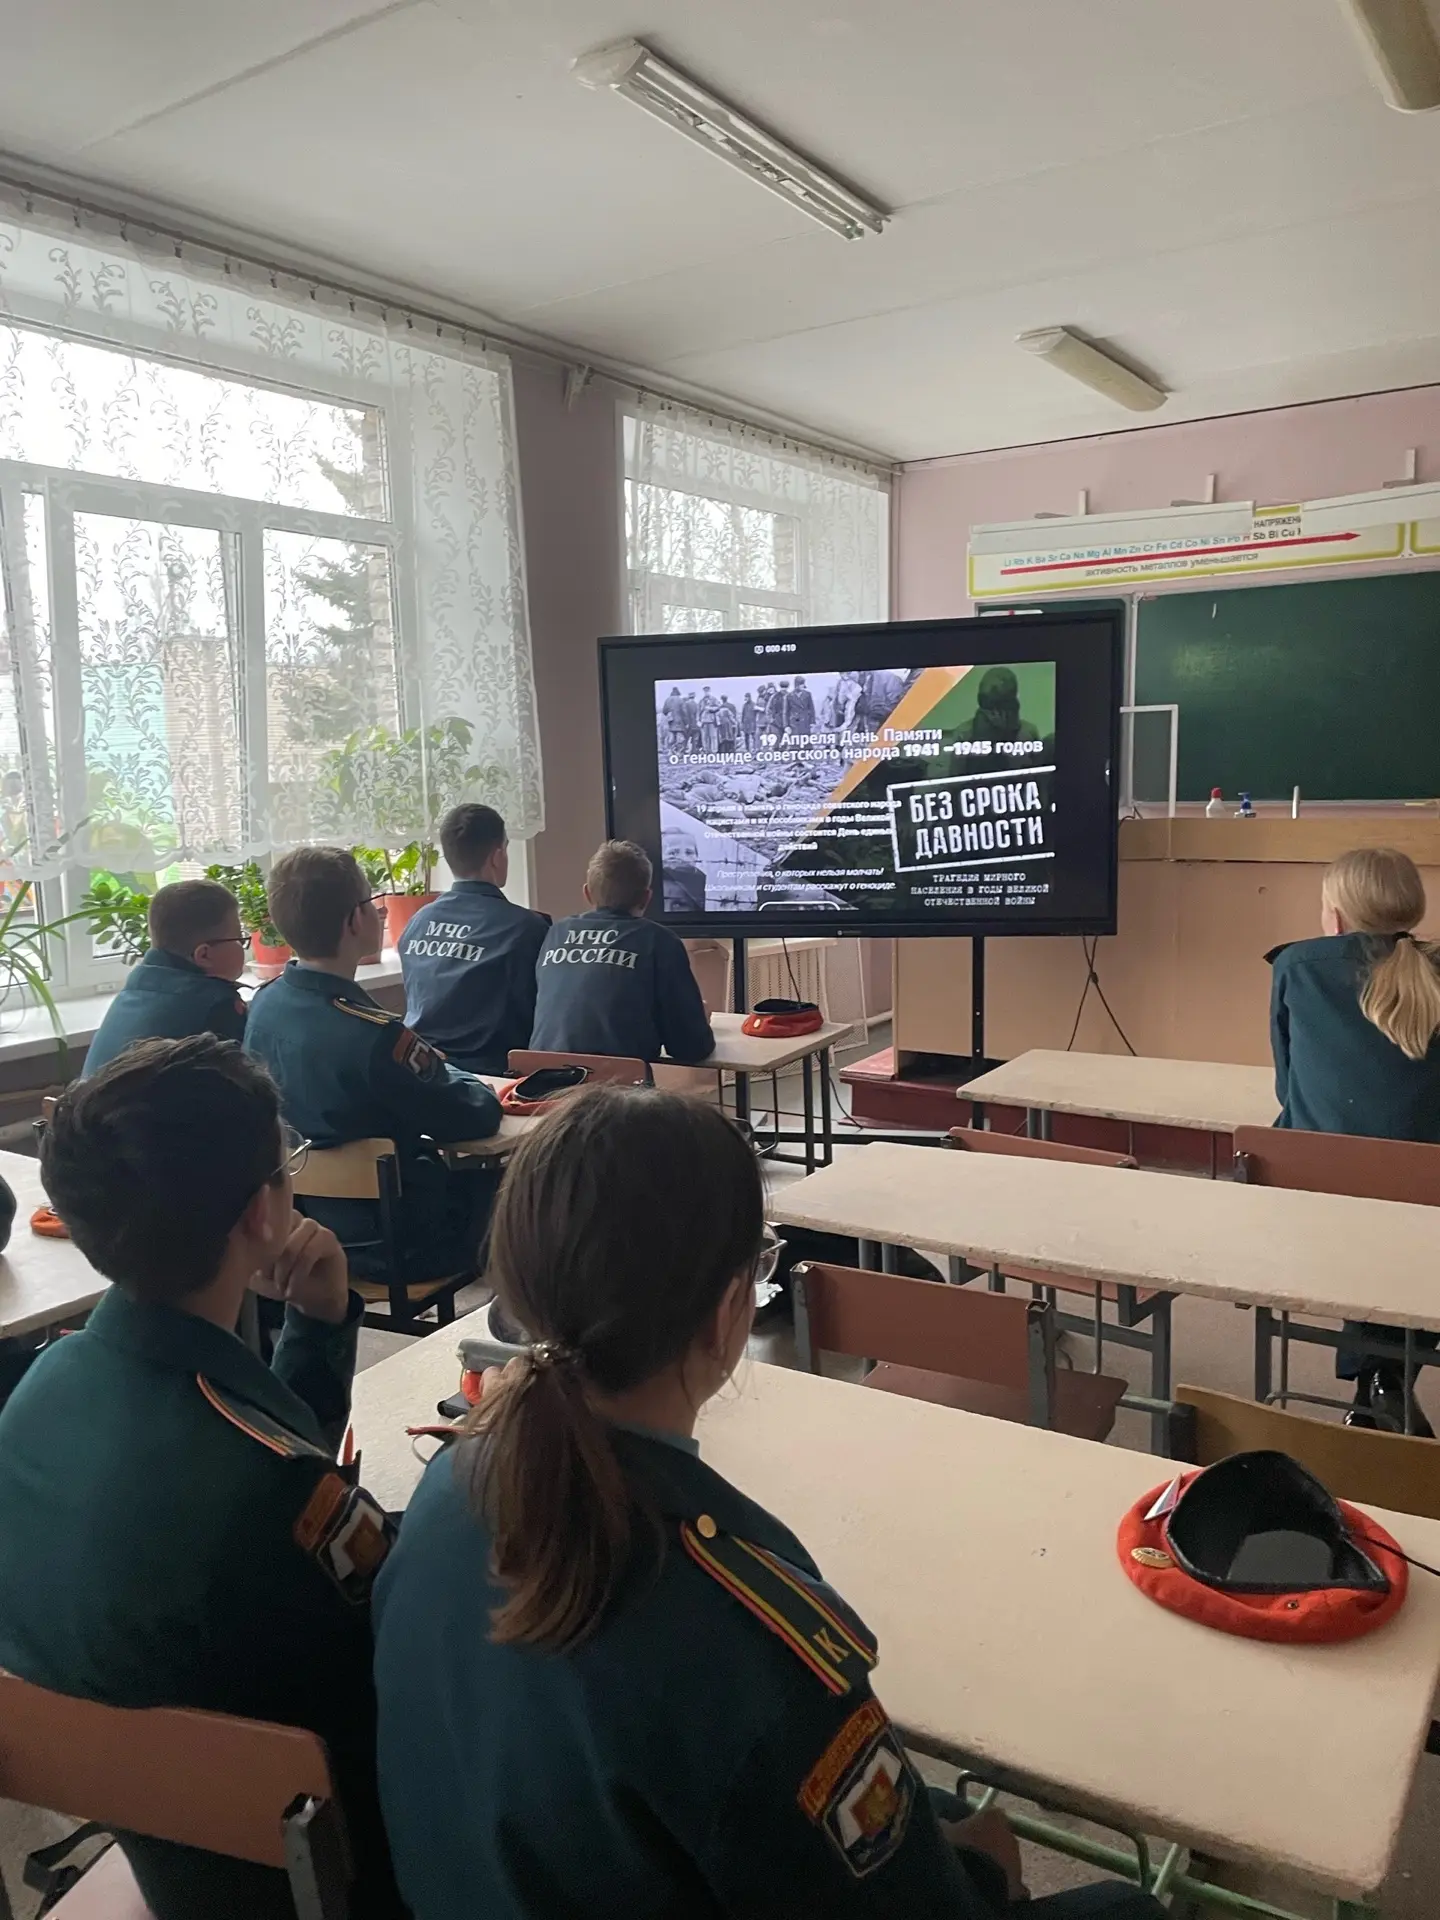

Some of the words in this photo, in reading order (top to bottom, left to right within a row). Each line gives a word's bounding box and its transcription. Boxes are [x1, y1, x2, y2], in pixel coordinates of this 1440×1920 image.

[1060, 553, 1071, 561] Ca
[1087, 550, 1100, 559] Mg
[1129, 546, 1141, 554] Zn
[1170, 541, 1182, 549] Cd
[1213, 536, 1225, 545] Sn
[1253, 532, 1266, 541] Sb
[1268, 530, 1279, 539] Bi
[1281, 529, 1295, 537] Cu
[759, 733, 778, 747] 19
[780, 732, 836, 749] Апреля
[840, 730, 879, 746] День
[883, 728, 942, 742] Памяти
[669, 755, 679, 765] о
[683, 752, 752, 765] геноциде
[756, 748, 840, 762] советского
[844, 745, 900, 761] народа
[903, 743, 940, 757] 1941
[995, 740, 1043, 755] годов
[909, 791, 954, 823] БЕЗ
[960, 781, 1042, 817] СРОКА
[915, 816, 1044, 860] ДАВНОСТИ
[933, 874, 980, 883] ТРАГЕДИЯ
[983, 873, 1027, 882] МИРНОГО
[910, 886, 963, 895] НАСЕЛЕНИЯ
[967, 886, 974, 894] В
[978, 885, 1003, 894] ГОДЫ
[1007, 884, 1049, 893] ВЕЛИКОЙ
[924, 896, 1000, 906] ОТЕЧЕСТВЕННОЙ
[1004, 896, 1036, 905] ВОЙНЫ
[425, 920, 472, 939] МЧС
[564, 929, 620, 945] МЧС
[404, 939, 485, 962] РОССИИ
[541, 947, 638, 970] РОССИИ
